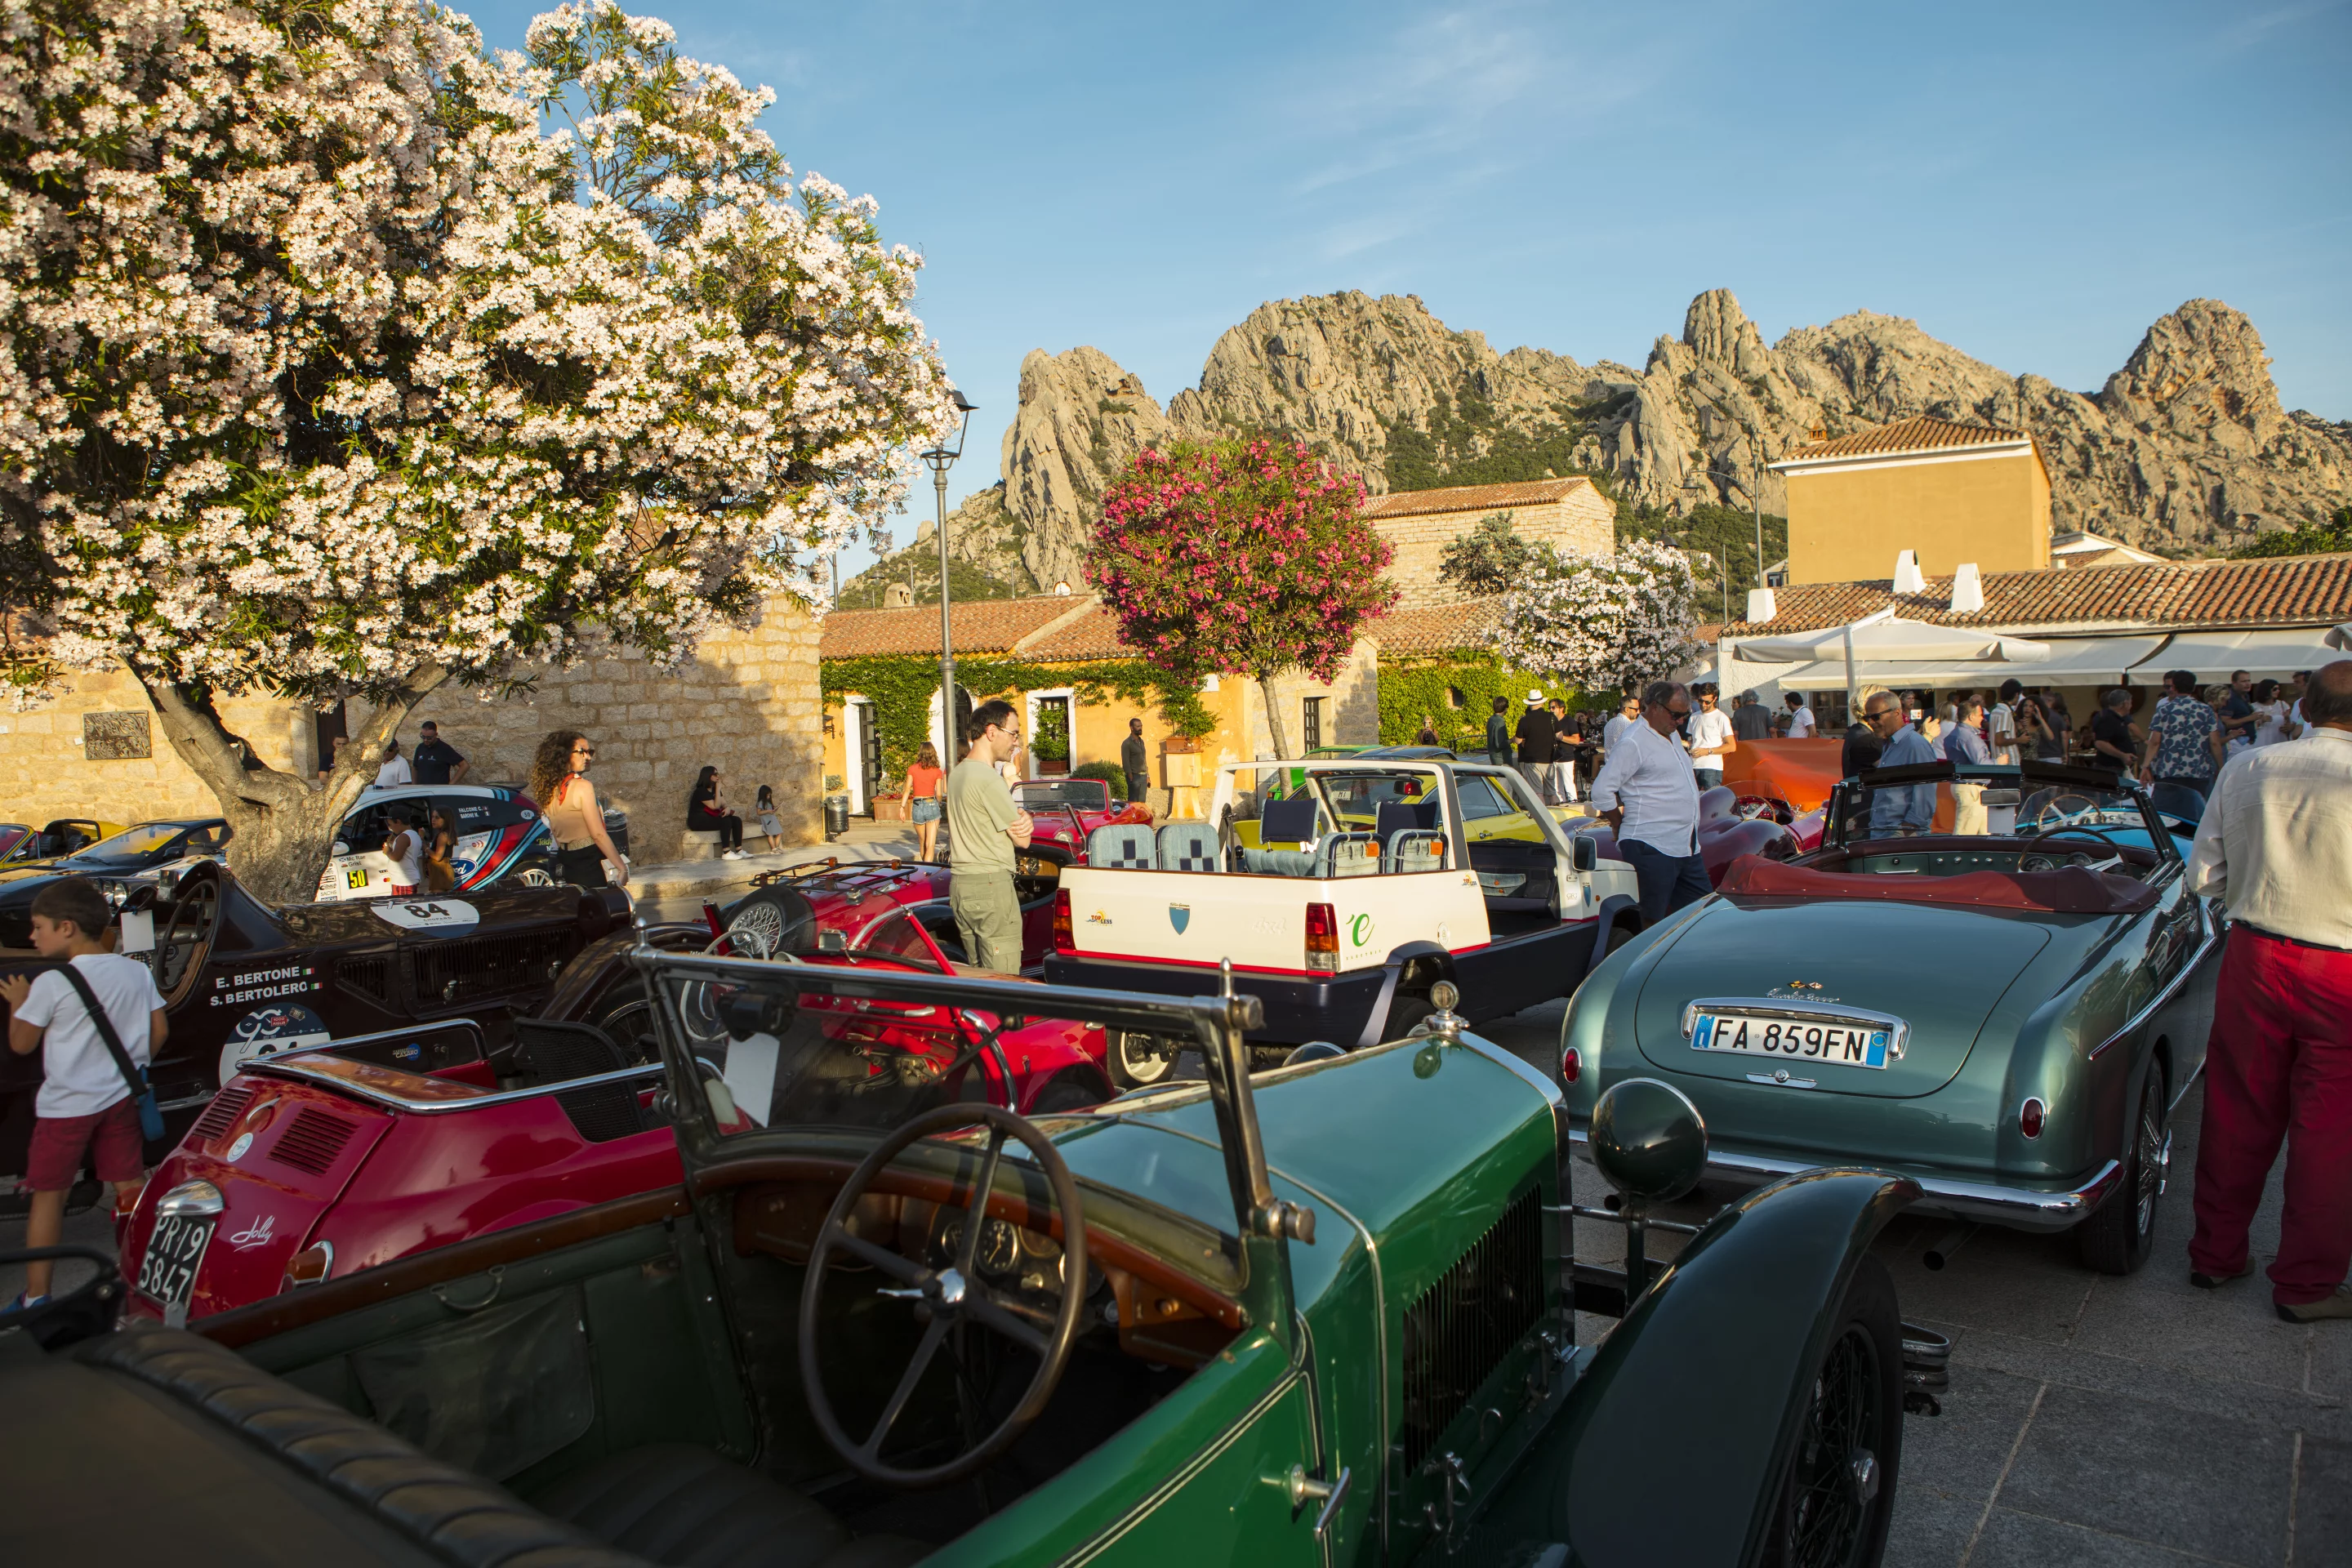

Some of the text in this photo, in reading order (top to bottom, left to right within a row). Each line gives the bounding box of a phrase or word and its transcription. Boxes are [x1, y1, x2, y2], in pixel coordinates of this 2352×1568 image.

[349, 870, 366, 889] 50
[403, 902, 450, 919] 84
[1346, 949, 1383, 960] ELECTRIC
[216, 966, 301, 989] E. BERTONE
[210, 981, 308, 1006] S. BERTOLERO
[1713, 1018, 1748, 1049] FA
[1762, 1023, 1866, 1062] 859FN
[229, 1214, 276, 1253] Jolly
[138, 1251, 192, 1303] 5847
